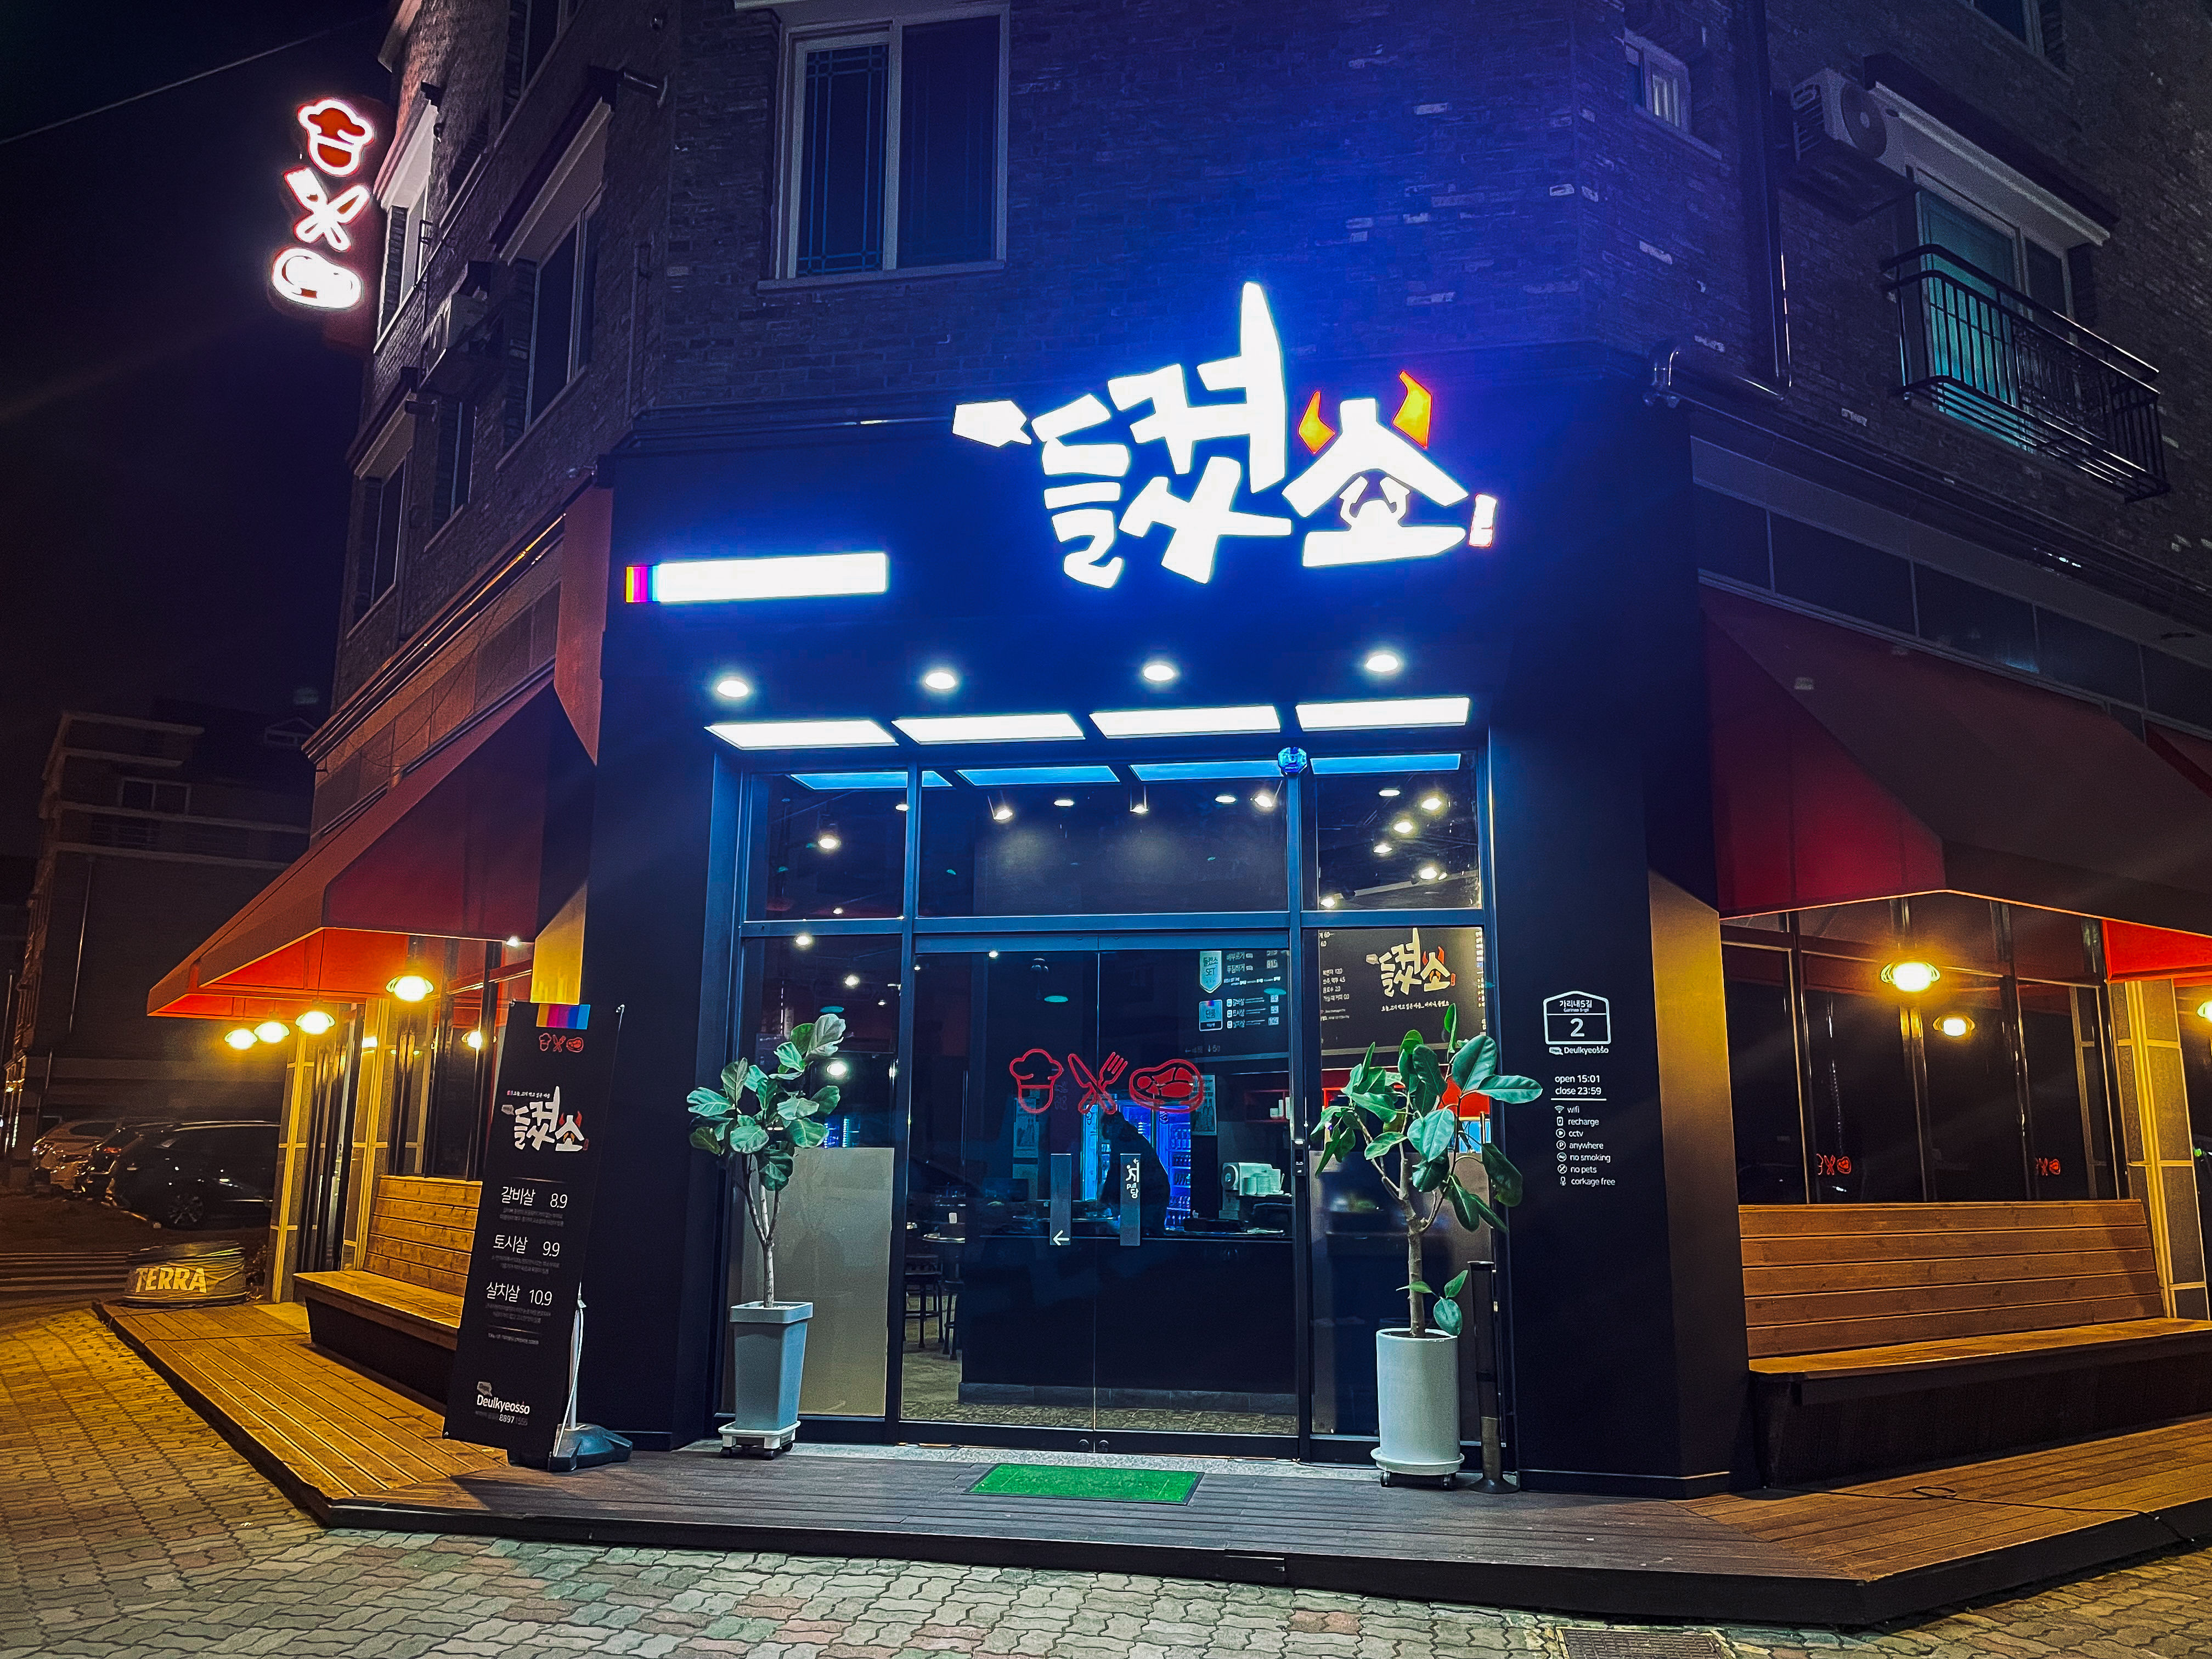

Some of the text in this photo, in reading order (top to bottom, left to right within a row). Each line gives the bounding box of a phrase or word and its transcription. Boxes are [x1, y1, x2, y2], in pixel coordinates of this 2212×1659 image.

[1559, 1000, 1592, 1008] 가리내5길
[1570, 1018, 1585, 1037] 2
[1554, 1075, 1600, 1084] open 15:01
[1555, 1087, 1601, 1095] close 23:59
[1568, 1118, 1599, 1127] recharge
[1569, 1142, 1604, 1150] anywhere
[1581, 1154, 1611, 1163] smoking
[1571, 1178, 1600, 1187] corkage
[501, 1187, 568, 1209] 갈비살 8.9
[493, 1234, 560, 1257] 토시살 9.9
[135, 1267, 207, 1294] TERRA
[486, 1282, 552, 1306] 살치살 10.9
[476, 1394, 531, 1415] Deulkyeosso
